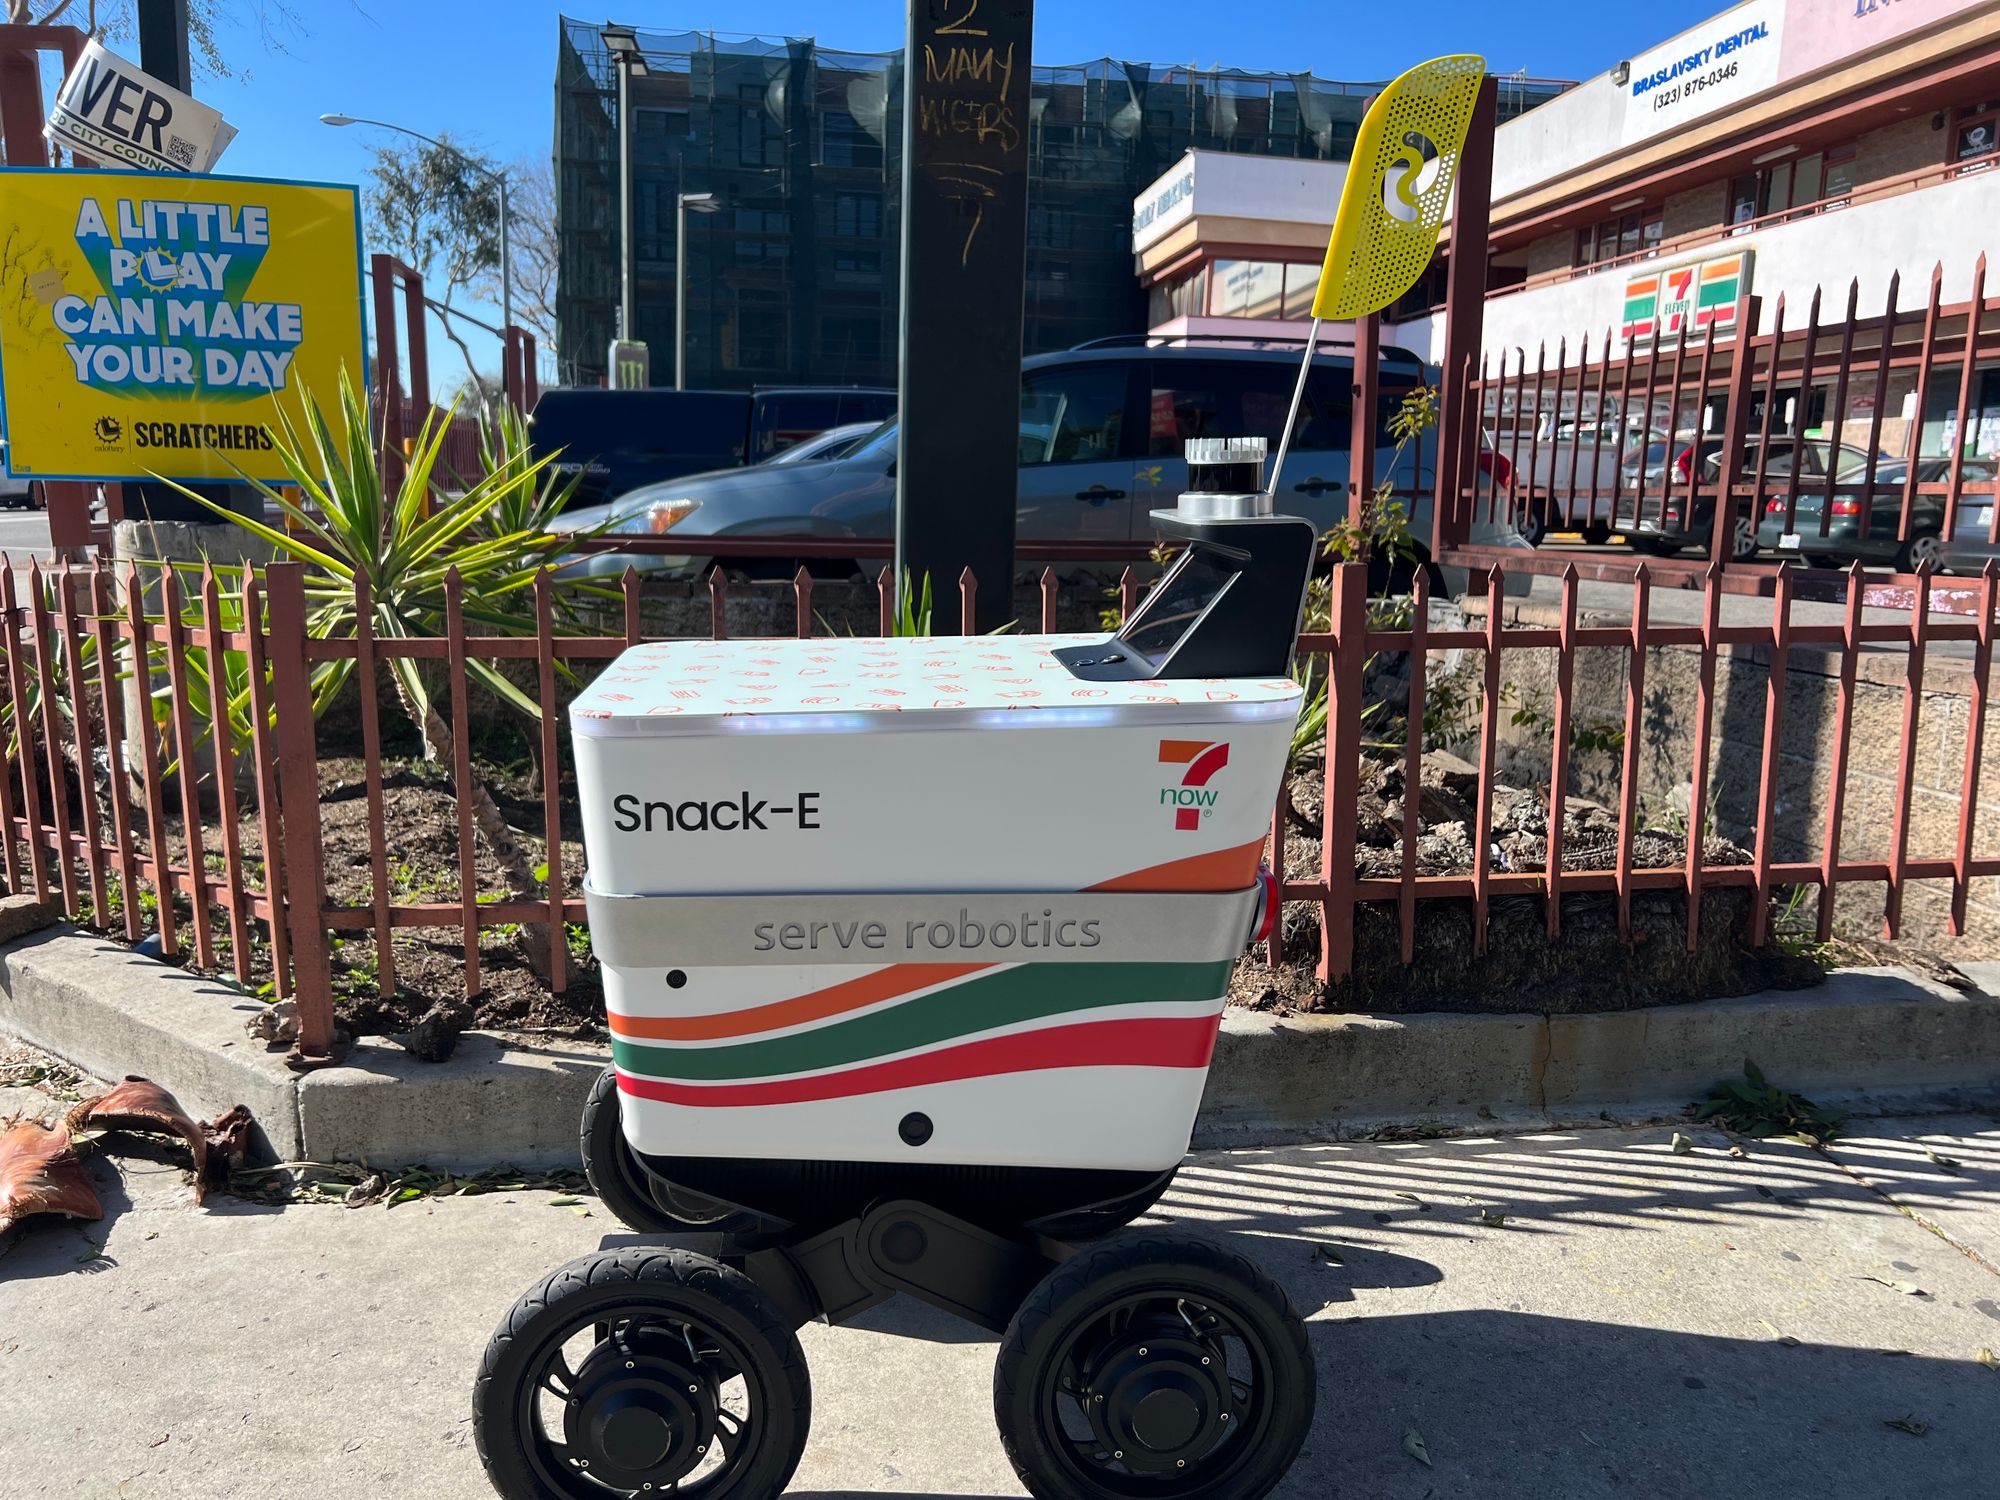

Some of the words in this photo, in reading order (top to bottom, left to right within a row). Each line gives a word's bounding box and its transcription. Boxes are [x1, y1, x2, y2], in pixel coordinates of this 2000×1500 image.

[924, 42, 1014, 104] MANY
[1632, 46, 1713, 97] BRASLAVSKY
[1715, 21, 1769, 59] DENTAL
[1653, 84, 1681, 112] (323)
[1684, 61, 1738, 97] 876-0346
[70, 123, 109, 147] CITY
[75, 198, 110, 238] A
[117, 199, 269, 246] LITTLE
[109, 246, 232, 294] PLAY
[53, 294, 157, 336] CAN
[165, 299, 303, 342] MAKE
[1667, 268, 1694, 332] 7
[64, 343, 196, 385] YOUR
[204, 348, 294, 388] DAY
[134, 421, 274, 451] SCRATCHERS
[613, 791, 820, 832] Snack-E
[1160, 787, 1219, 807] now
[753, 919, 887, 951] serve
[905, 908, 1101, 950] robotics
